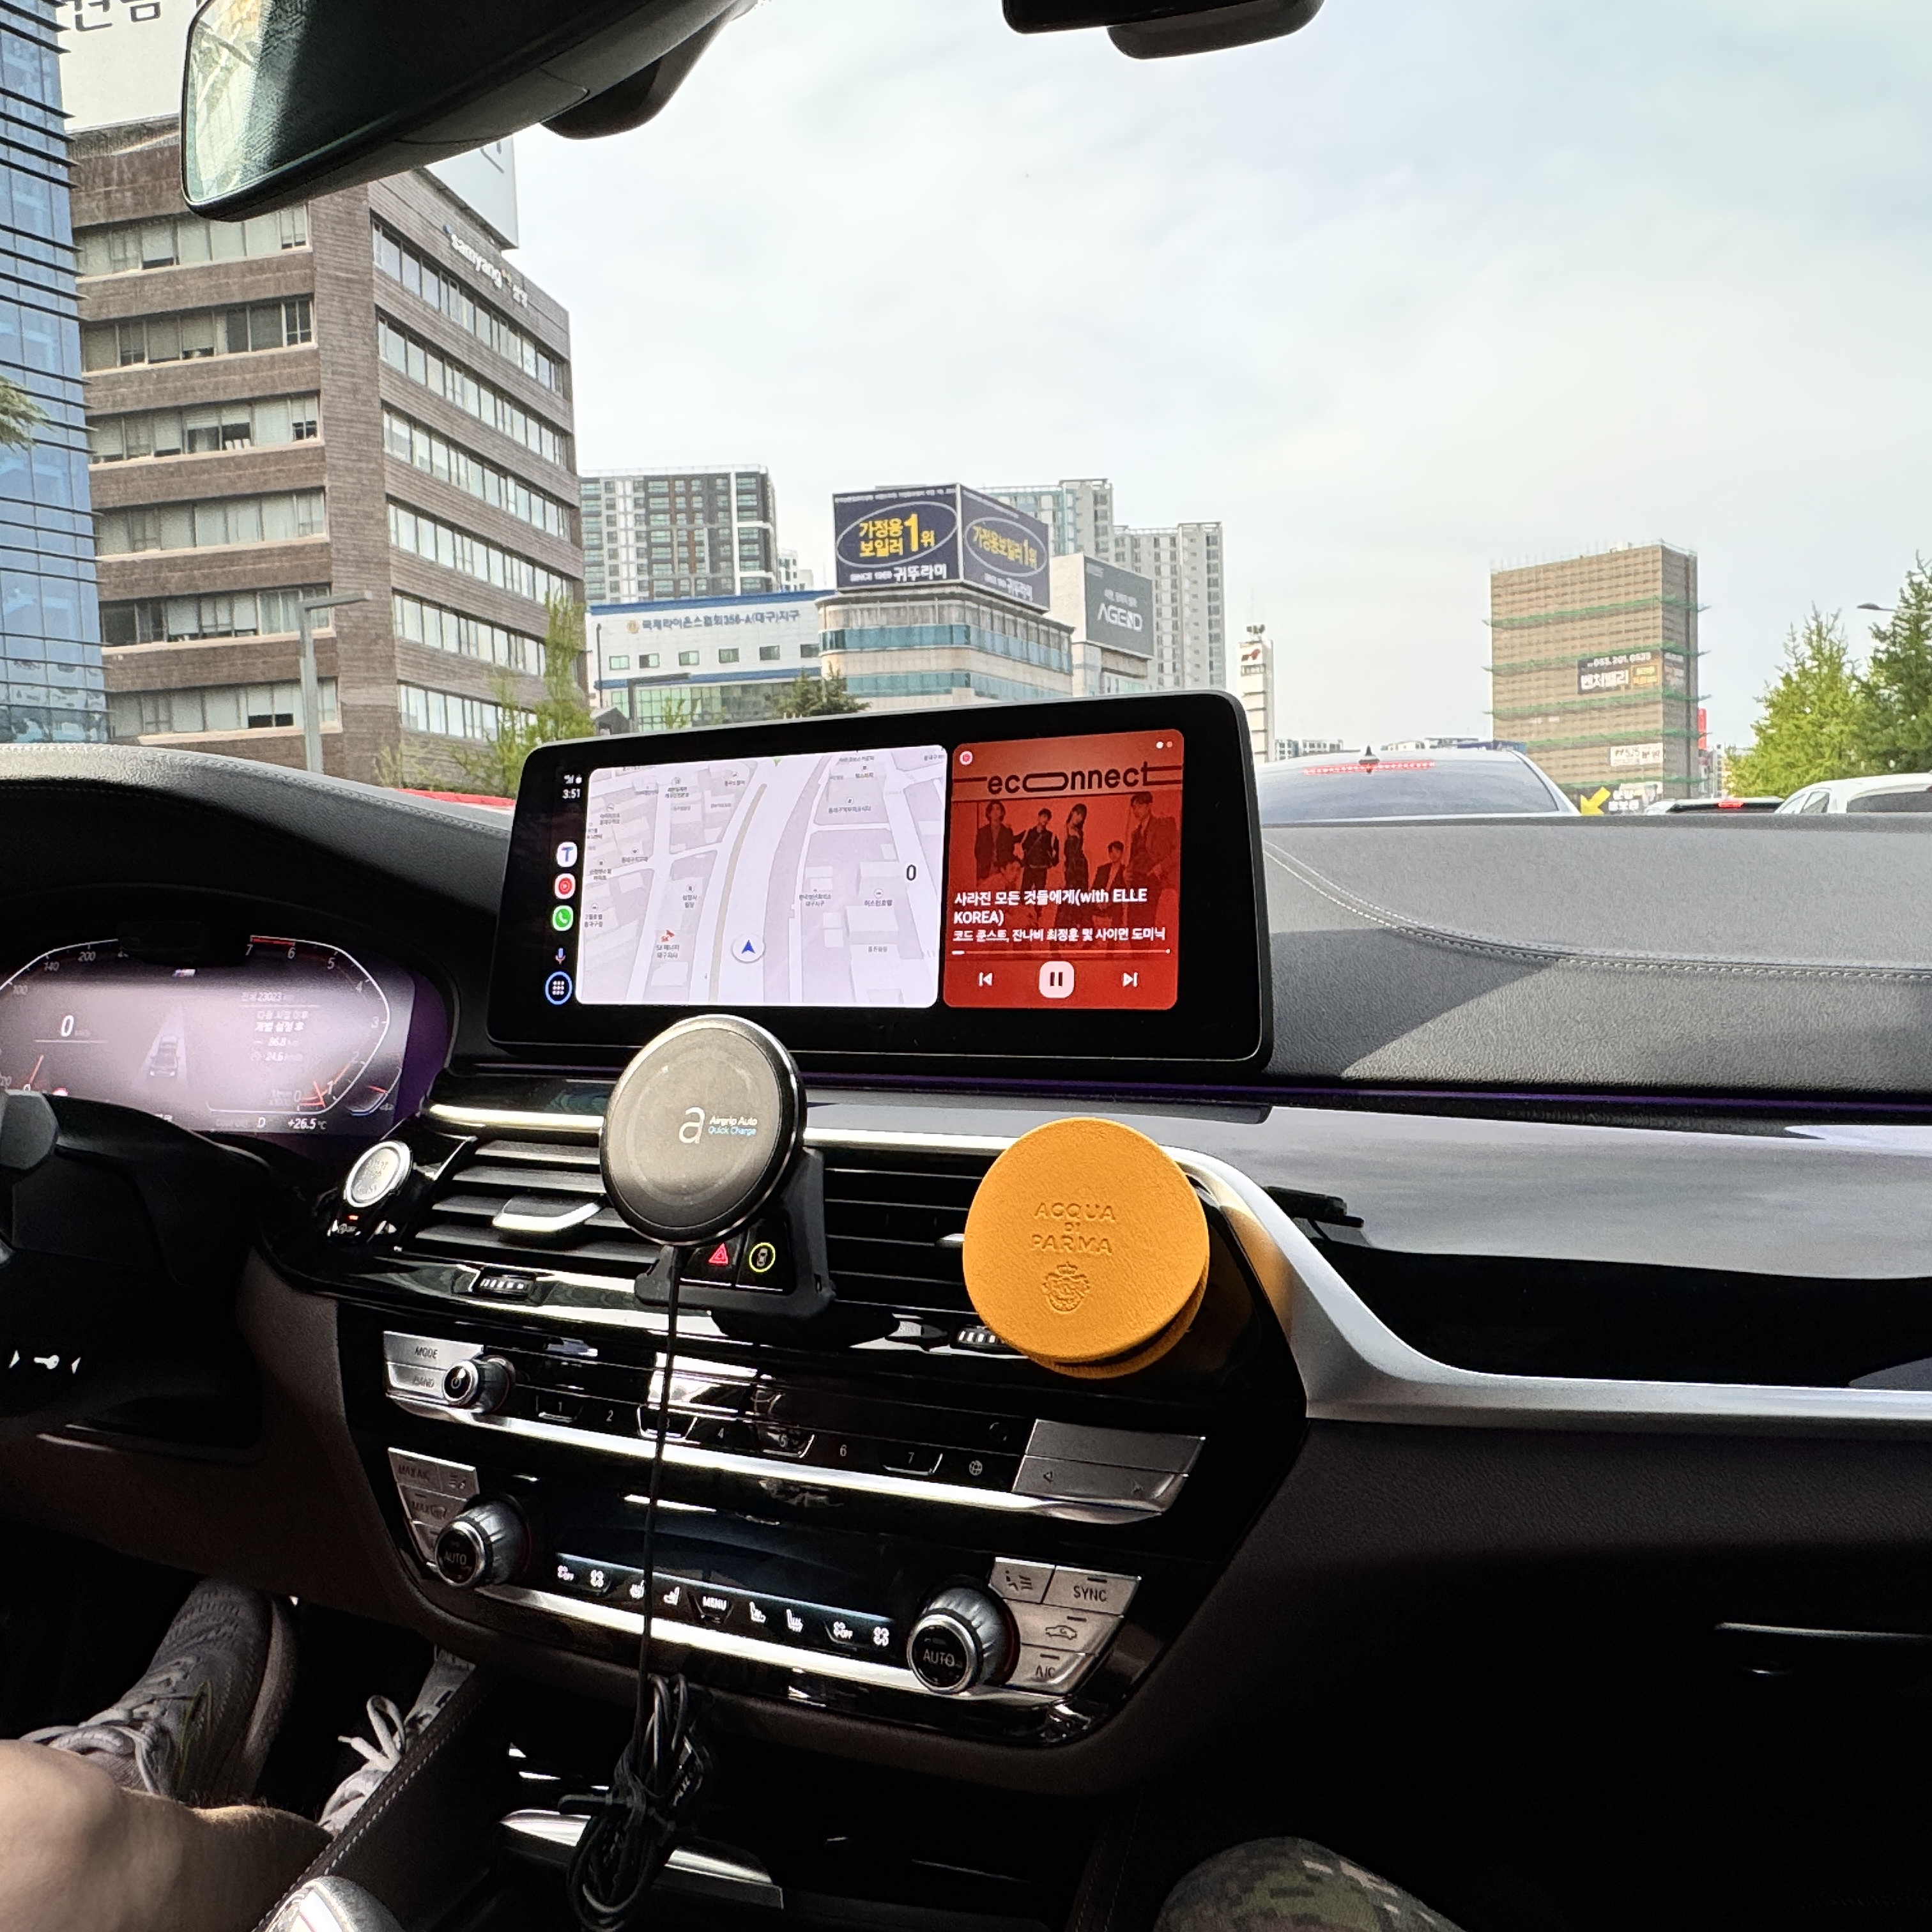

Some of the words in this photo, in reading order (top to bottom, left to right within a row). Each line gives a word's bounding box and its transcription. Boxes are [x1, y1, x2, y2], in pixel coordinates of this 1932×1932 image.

[859, 518, 903, 539] 가정용
[859, 537, 903, 558] 보일러
[893, 564, 947, 583] 귀뚜라미
[562, 788, 581, 799] 3:51
[906, 864, 916, 881] 0
[954, 891, 991, 906] 사라진
[994, 891, 1021, 906] 모든
[1023, 888, 1109, 906] 것들에게(with
[1112, 888, 1148, 903] ELLE
[953, 910, 1004, 926] KOREA)
[953, 930, 974, 942] 코드
[976, 930, 1009, 943] 쿤스트,
[1012, 928, 1044, 942] 잔나비
[1046, 928, 1079, 942] 최정훈
[1082, 928, 1093, 942] 및
[1095, 927, 1129, 942] 사이먼
[1131, 926, 1166, 941] 도미닉
[77, 951, 96, 962] 200
[245, 944, 254, 956] 7
[288, 947, 296, 959] 6
[326, 957, 336, 970] 5
[355, 981, 364, 992] 4
[60, 1015, 75, 1037] 0
[371, 1016, 380, 1029] 3
[294, 1090, 302, 1102] 0
[257, 1117, 266, 1128] D
[737, 1116, 758, 1126] Auto
[708, 1125, 729, 1135] Quick
[730, 1126, 757, 1136] Charge
[1033, 1202, 1116, 1222] ACQUA
[1030, 1234, 1113, 1257] PARMA
[415, 1346, 438, 1360] MODE
[557, 1401, 563, 1412] 1
[606, 1409, 614, 1422] 2
[717, 1427, 726, 1439] 4
[779, 1434, 788, 1448] 5
[839, 1444, 847, 1457] 6
[908, 1452, 915, 1464] 7
[443, 1551, 467, 1566] AUTO
[1073, 1584, 1108, 1603] SYNC
[702, 1595, 728, 1612] MENU
[923, 1648, 956, 1668] AUTO
[1035, 1664, 1055, 1679] A/C
